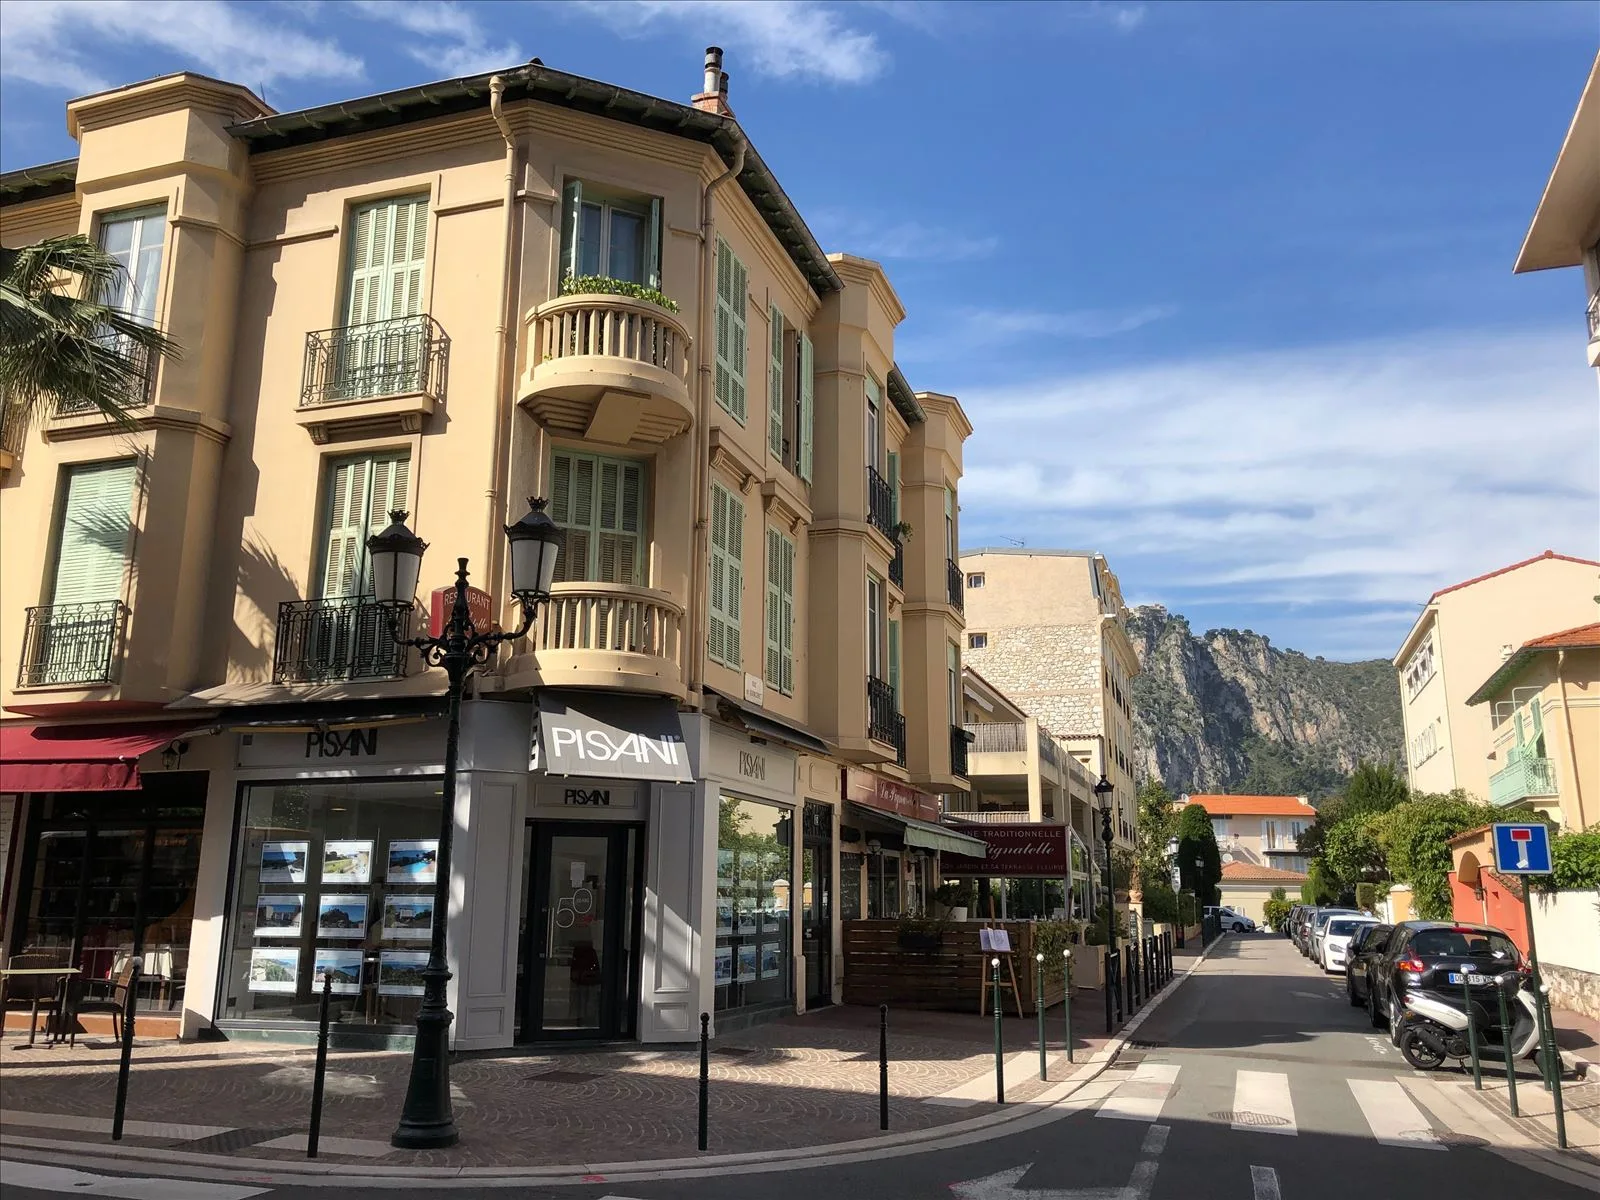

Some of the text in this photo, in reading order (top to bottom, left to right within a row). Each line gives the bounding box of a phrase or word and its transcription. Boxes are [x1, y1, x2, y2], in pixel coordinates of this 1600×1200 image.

[444, 591, 490, 611] RESURANT
[305, 728, 378, 758] PISANI
[551, 727, 679, 766] PISANI
[739, 750, 766, 781] PISANI
[564, 788, 611, 806] PISANI
[983, 830, 1061, 839] TRADITIONNELLE
[556, 888, 593, 929] 50
